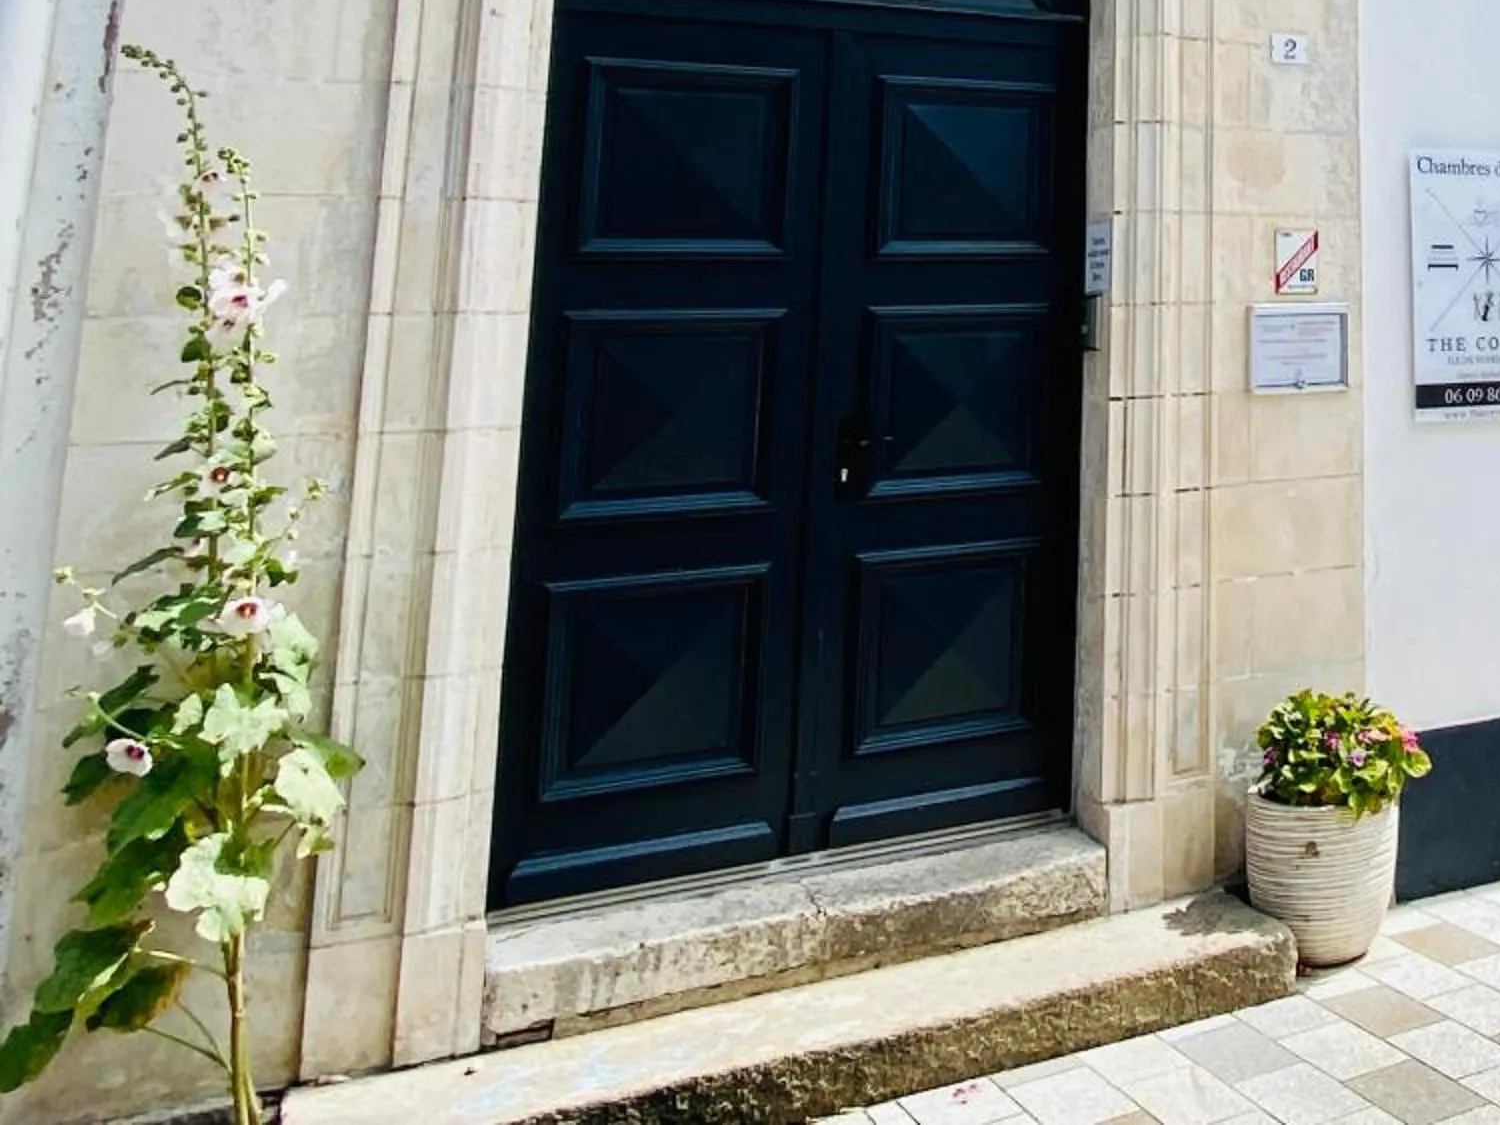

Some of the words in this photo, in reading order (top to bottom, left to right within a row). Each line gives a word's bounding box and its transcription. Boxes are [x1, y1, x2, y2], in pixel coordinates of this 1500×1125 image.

[1283, 38, 1297, 60] 2
[1416, 155, 1490, 176] Chambres
[1299, 268, 1315, 282] GR
[1426, 337, 1467, 352] THE
[1444, 388, 1463, 404] 06
[1465, 387, 1484, 402] 09
